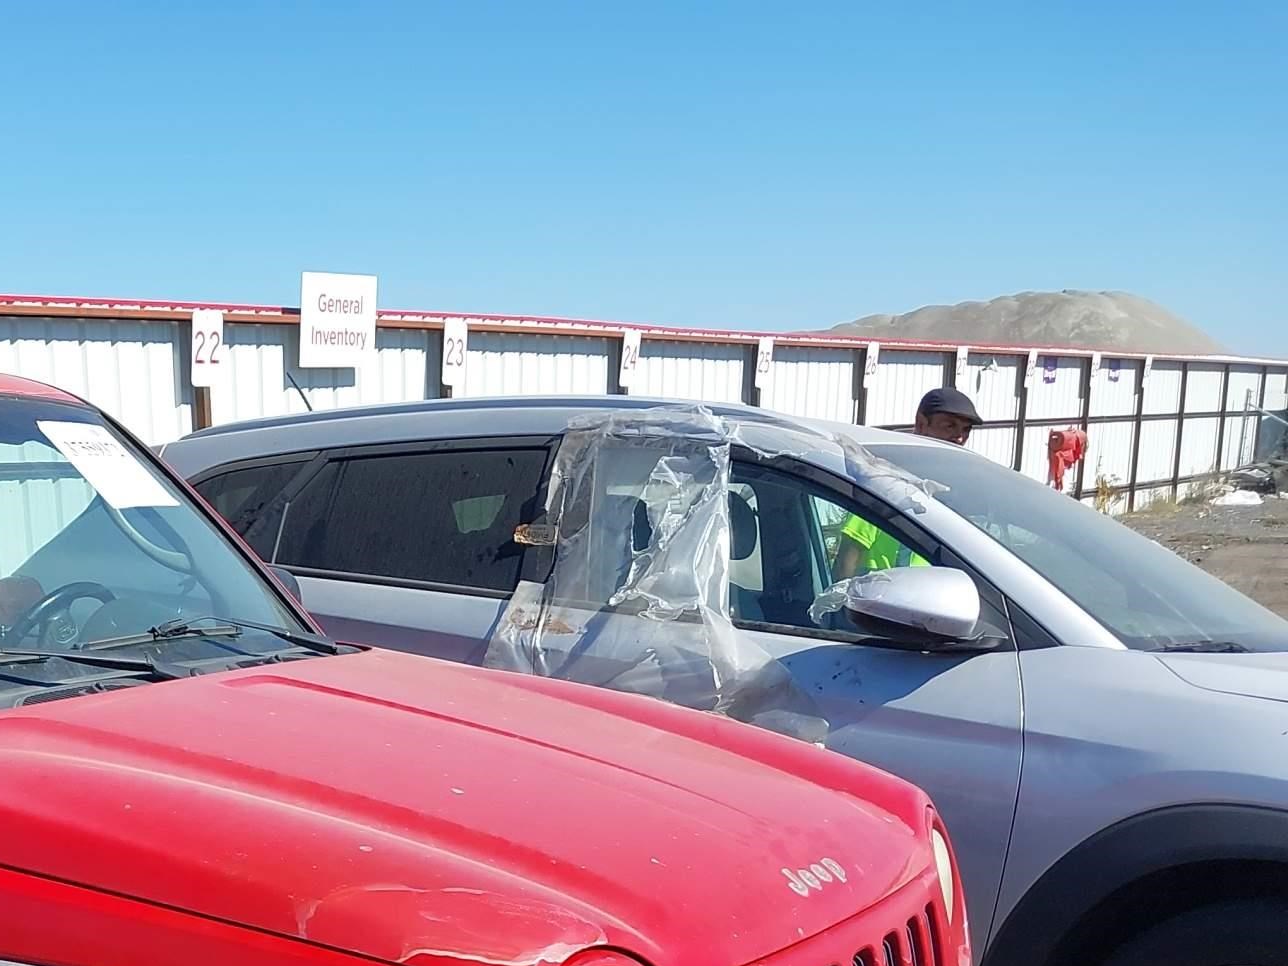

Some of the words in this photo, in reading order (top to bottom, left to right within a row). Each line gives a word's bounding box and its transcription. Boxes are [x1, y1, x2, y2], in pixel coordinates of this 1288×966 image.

[318, 293, 364, 314] General
[195, 330, 220, 364] 22
[311, 326, 367, 350] Inventory
[446, 337, 464, 367] 23
[624, 345, 638, 370] 24
[758, 351, 770, 373] 25
[865, 355, 877, 375] 26
[780, 857, 847, 897] Jeep
